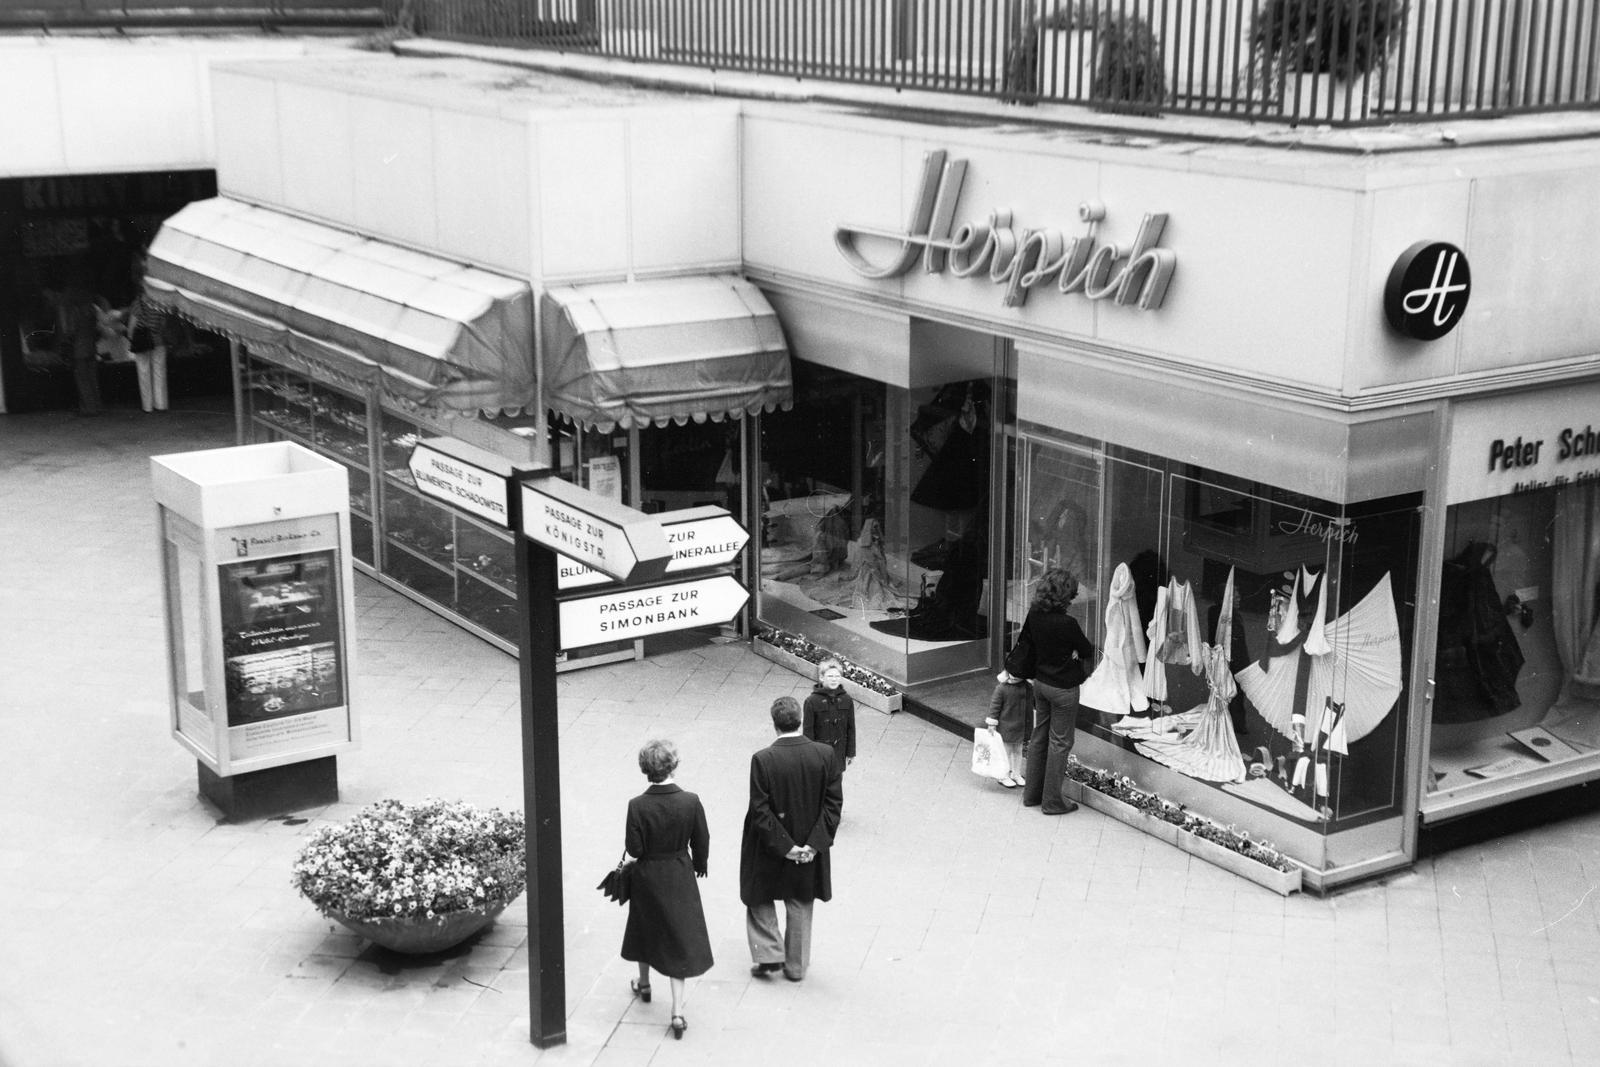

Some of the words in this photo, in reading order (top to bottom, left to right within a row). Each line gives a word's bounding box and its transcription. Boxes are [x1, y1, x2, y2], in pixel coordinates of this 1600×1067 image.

[834, 150, 1177, 309] Herpich
[1488, 437, 1544, 474] Peter
[431, 459, 464, 480] PASSAGE
[466, 472, 482, 487] ZUR
[545, 504, 583, 531] PASSAGE
[586, 523, 605, 541] ZUR
[668, 530, 697, 544] ZUR
[600, 595, 663, 615] PASSAGE
[671, 590, 700, 604] ZUR
[600, 607, 700, 632] SIMONBANK
